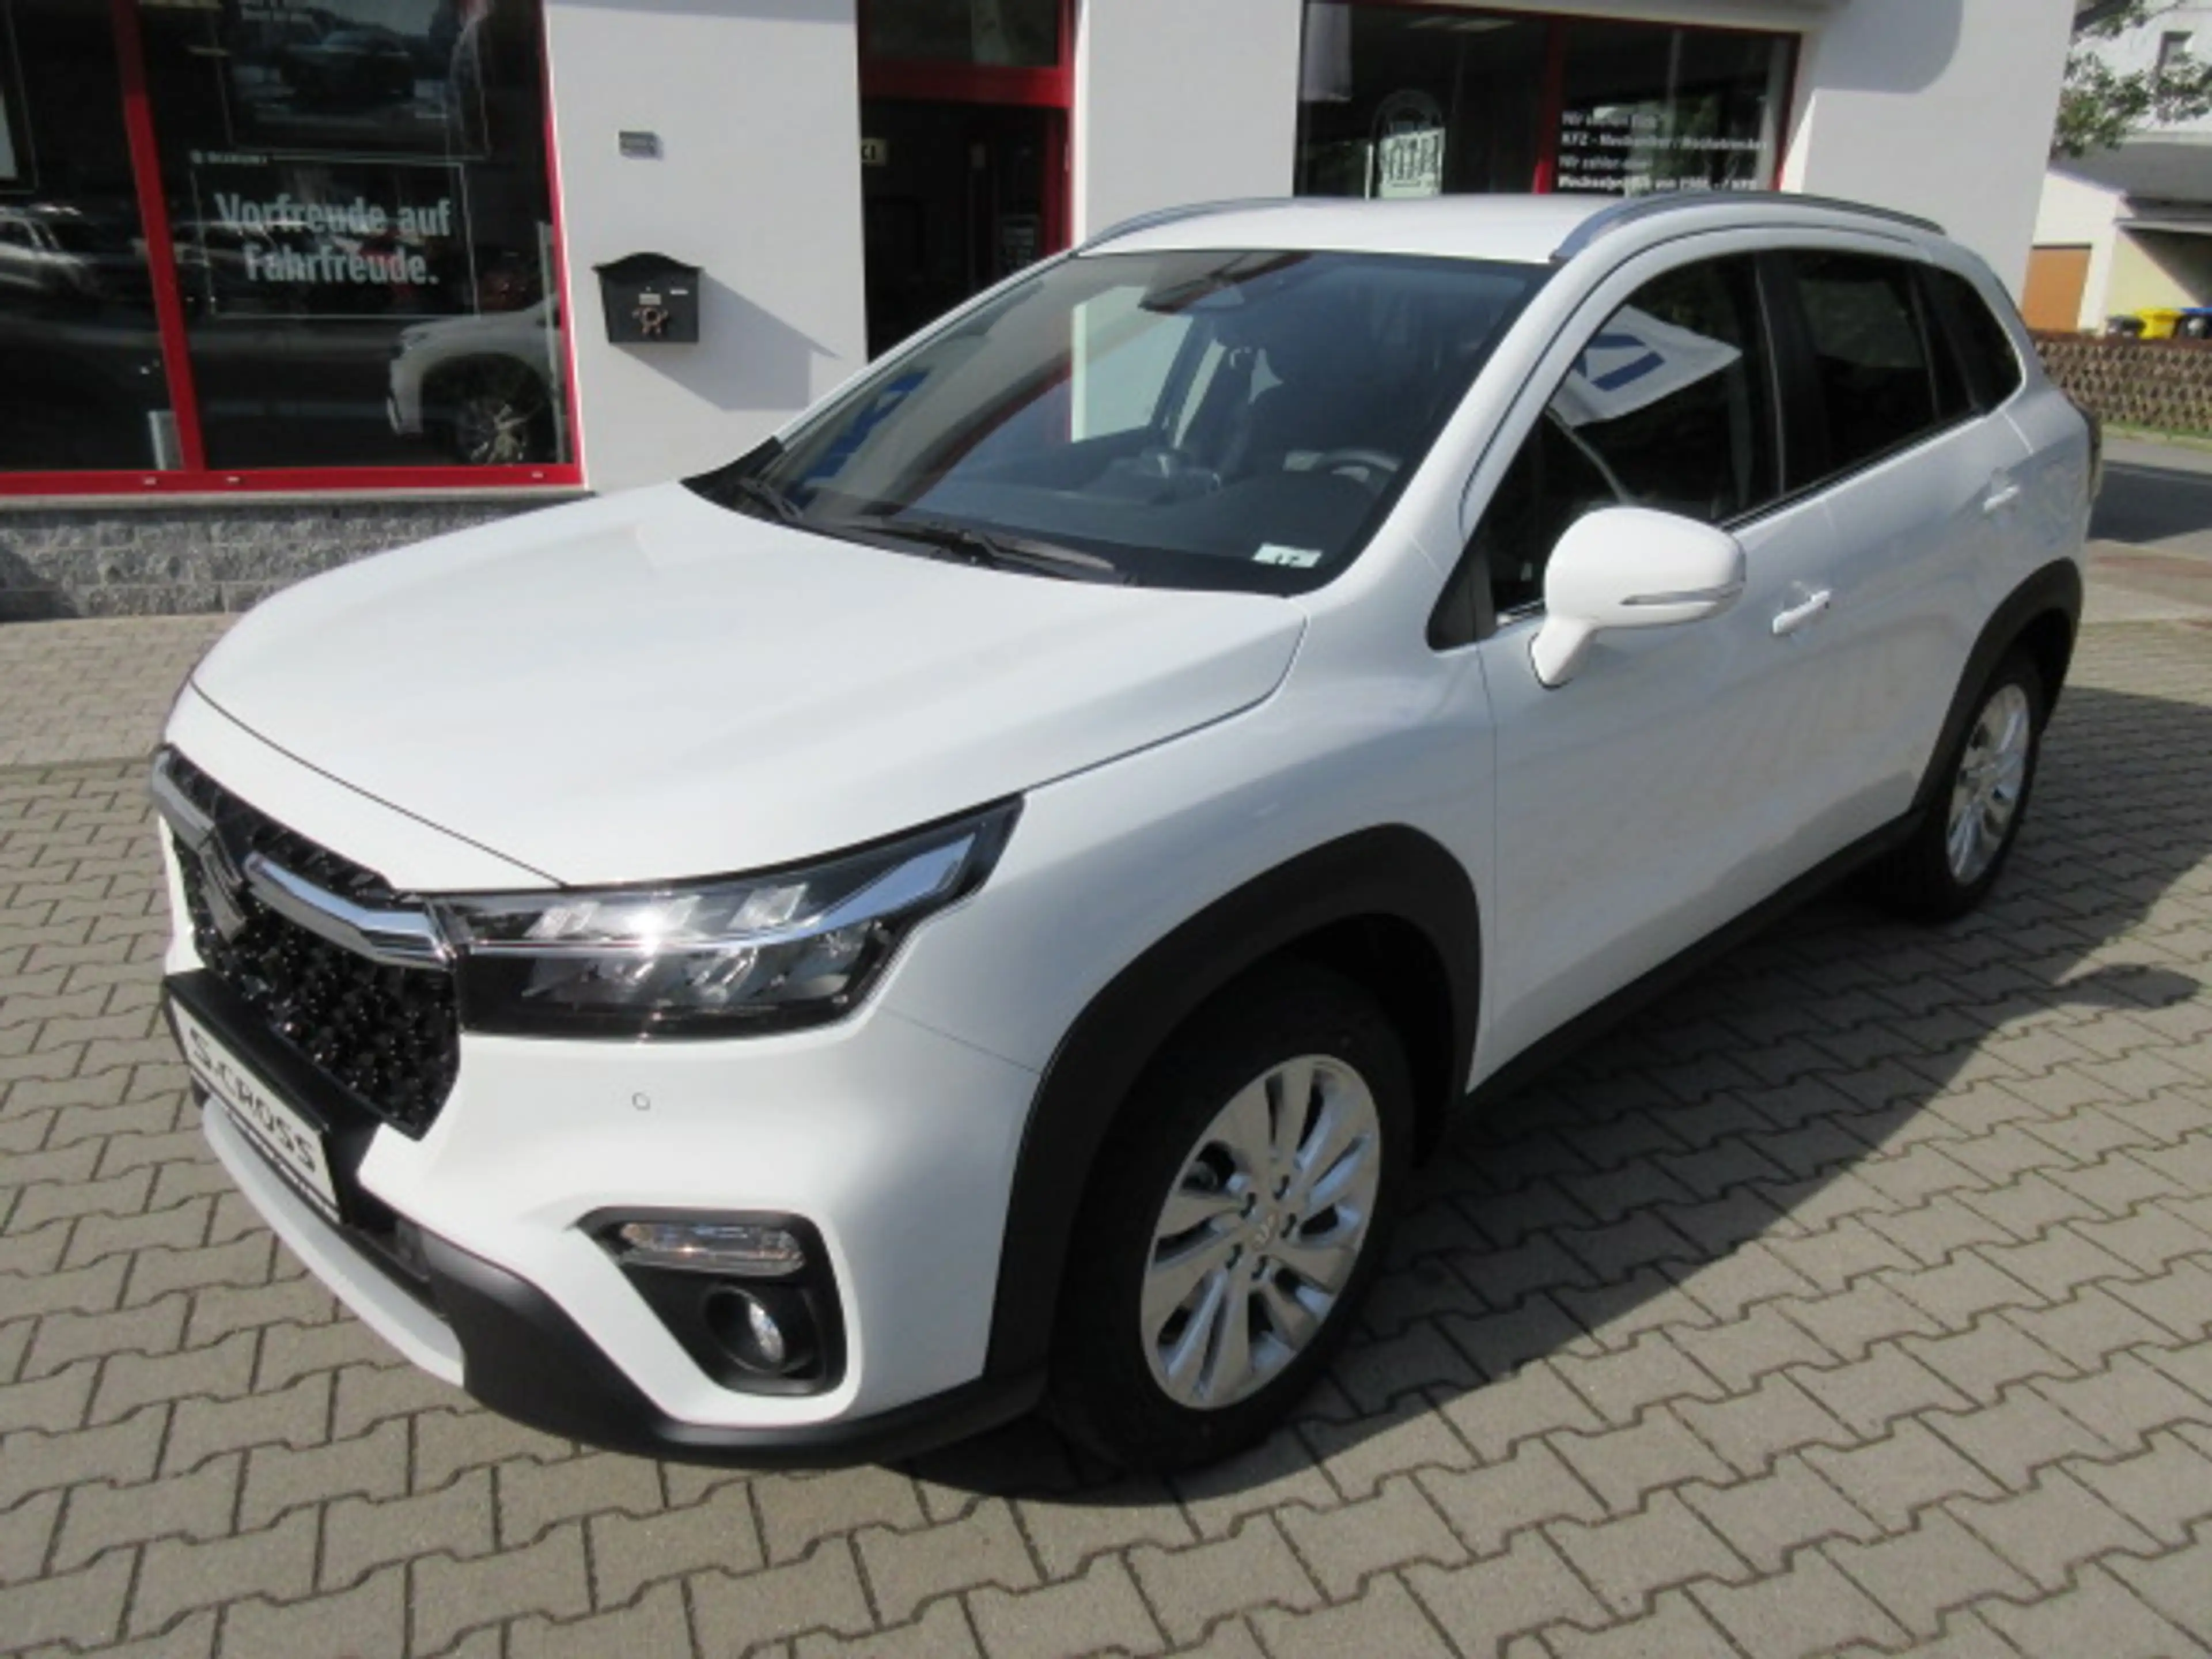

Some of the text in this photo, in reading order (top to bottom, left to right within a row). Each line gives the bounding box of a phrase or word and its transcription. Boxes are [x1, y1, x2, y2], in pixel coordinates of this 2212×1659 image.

[214, 191, 450, 237] Vorfreude auf
[243, 242, 440, 285] Fahrfreude.
